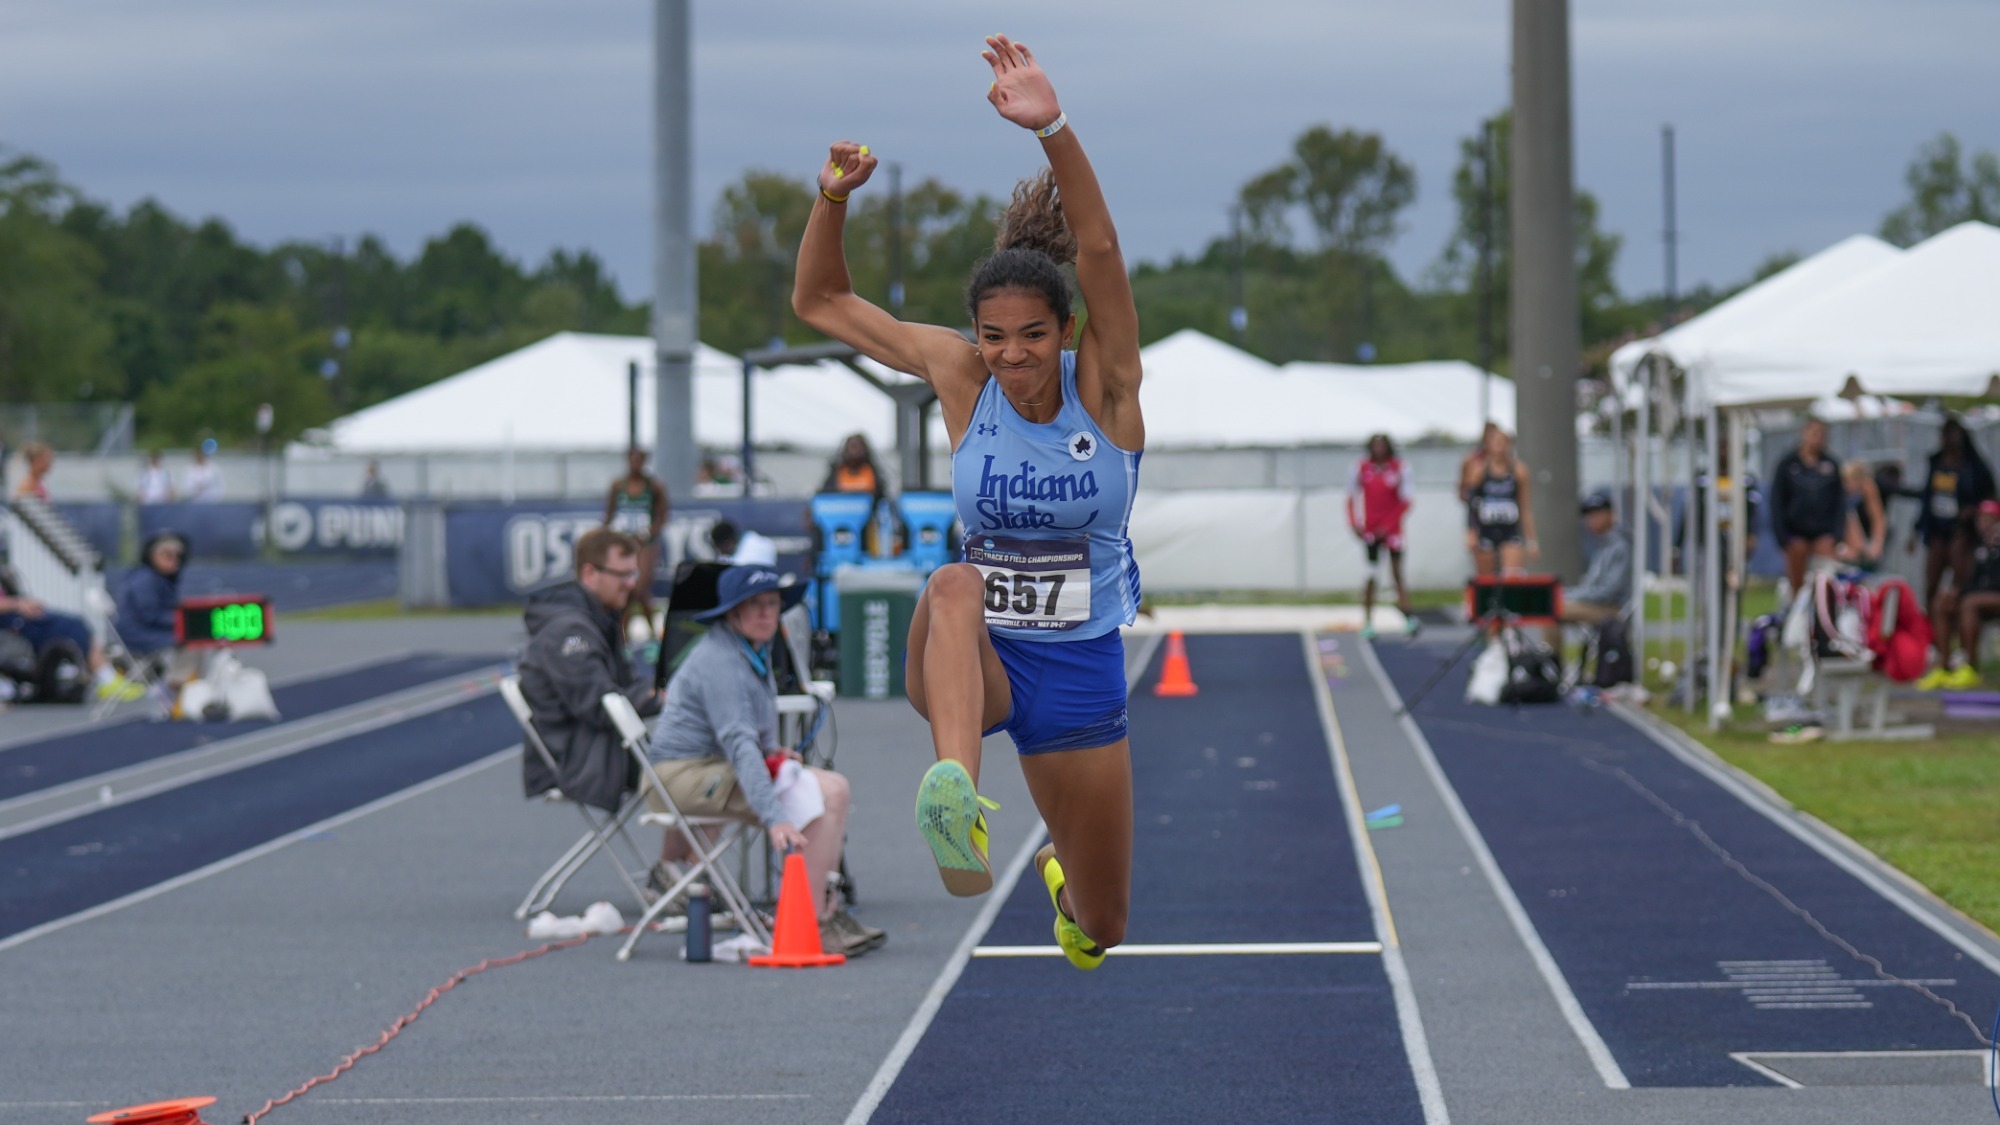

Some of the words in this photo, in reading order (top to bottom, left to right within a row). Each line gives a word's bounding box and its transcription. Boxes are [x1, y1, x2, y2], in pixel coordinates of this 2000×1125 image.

[976, 454, 1099, 502] Indiana
[976, 498, 1099, 530] State
[984, 552, 1004, 561] TRACK
[1009, 555, 1027, 563] FIELD
[1027, 553, 1084, 564] CHAMPIONSHIPS
[985, 571, 1066, 616] 657
